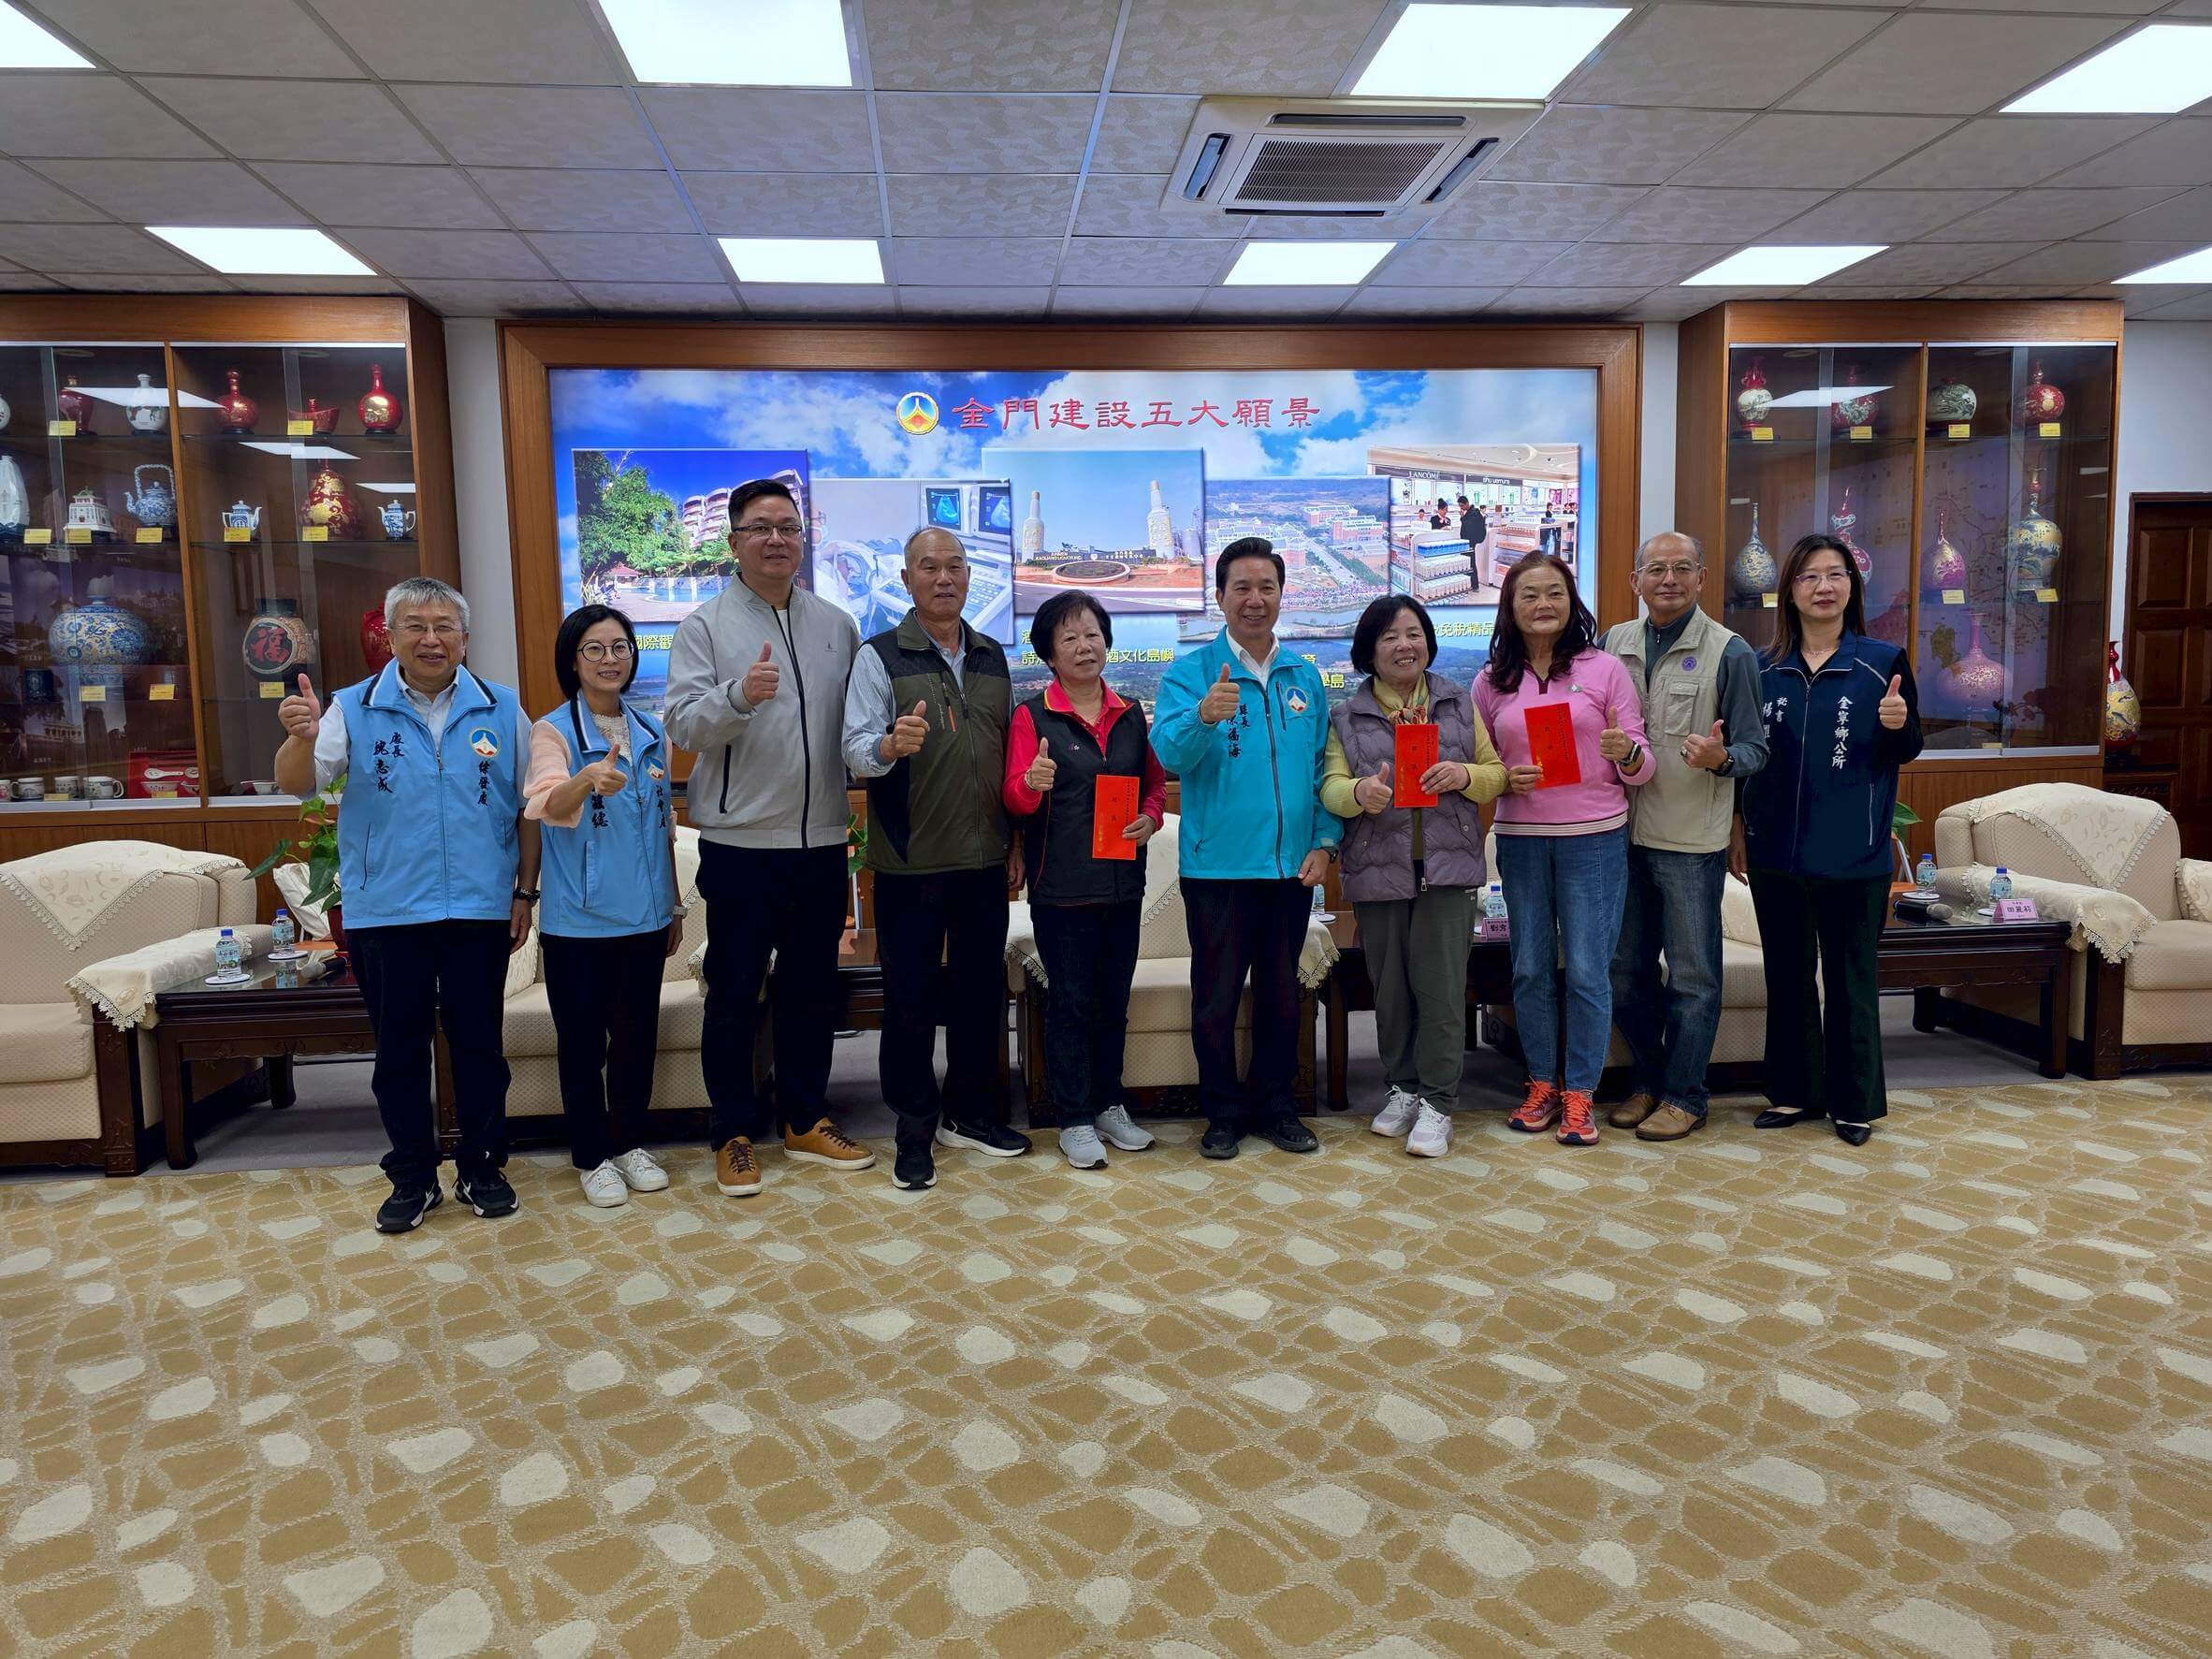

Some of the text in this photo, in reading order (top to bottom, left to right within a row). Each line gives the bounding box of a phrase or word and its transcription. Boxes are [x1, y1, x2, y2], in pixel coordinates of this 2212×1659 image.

[952, 397, 1320, 429] 金門建設五大願景
[250, 627, 290, 662] 福
[1433, 622, 1496, 637] 免稅精品
[1832, 696, 1853, 769] 金寧鄉公所
